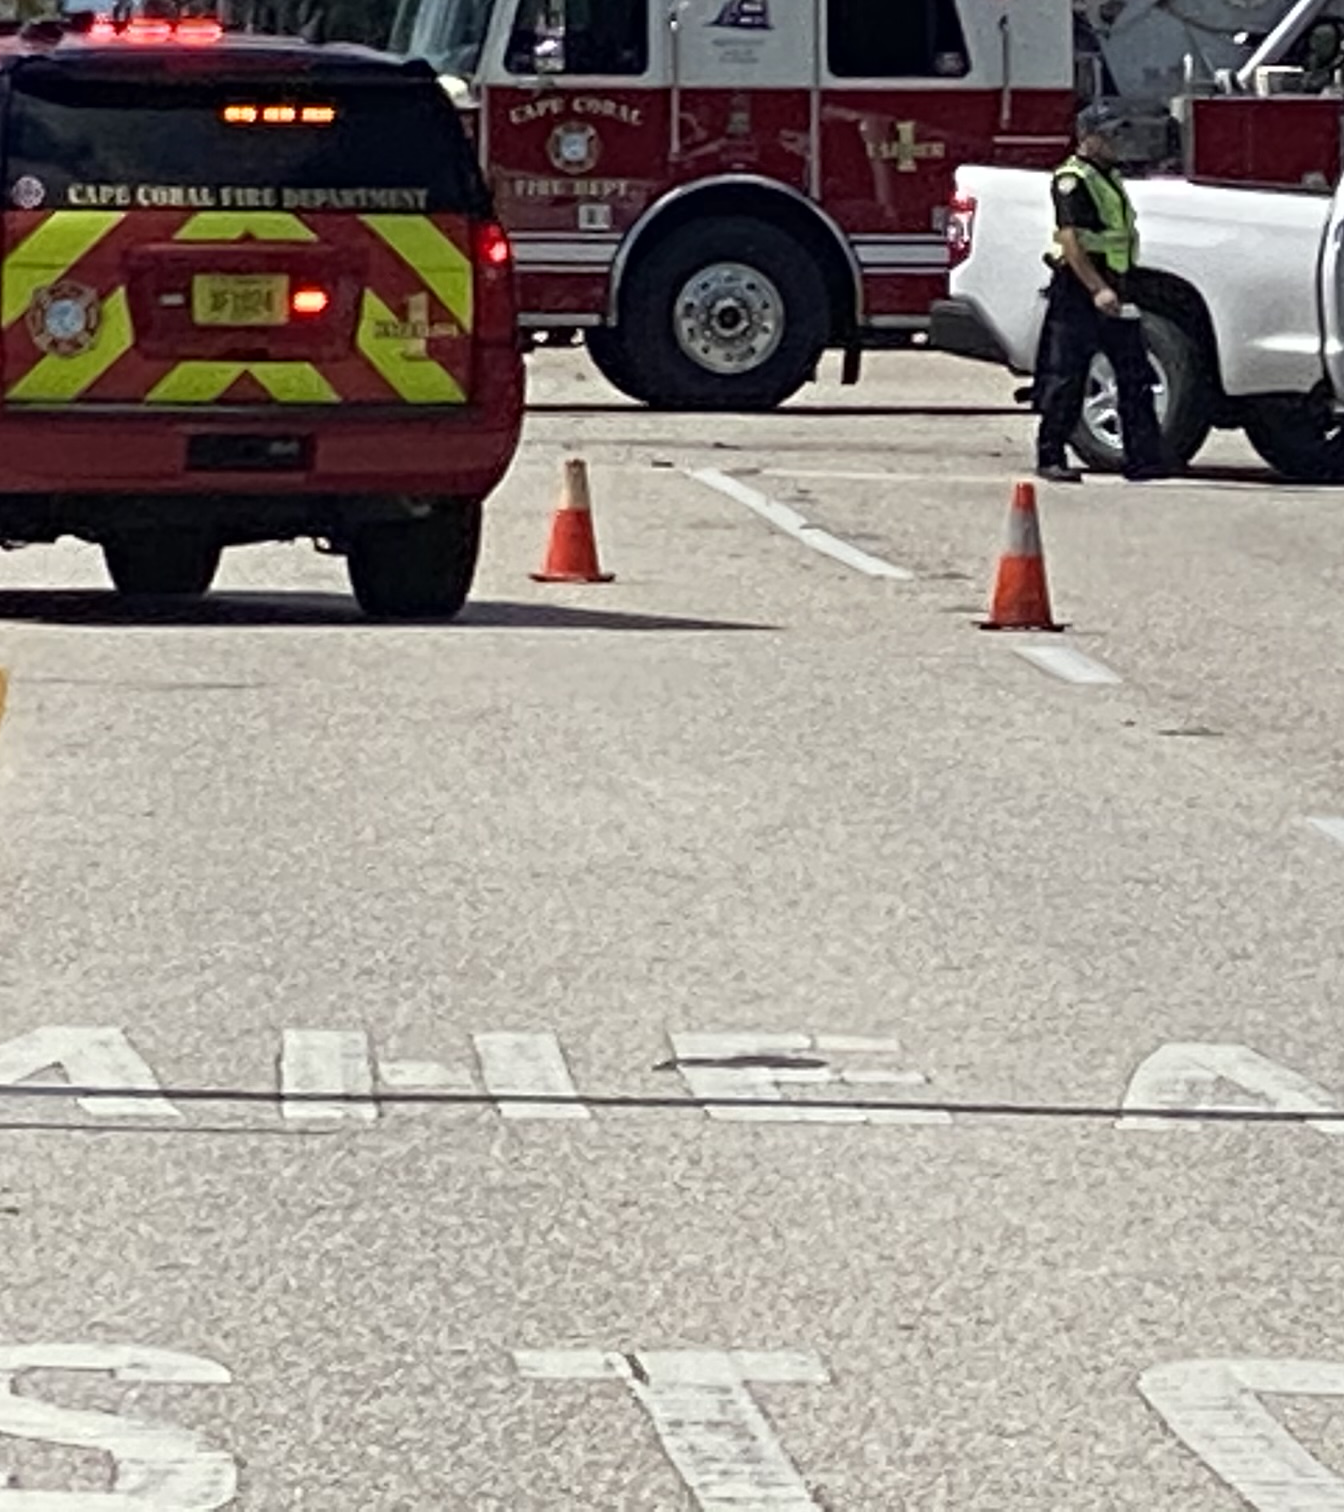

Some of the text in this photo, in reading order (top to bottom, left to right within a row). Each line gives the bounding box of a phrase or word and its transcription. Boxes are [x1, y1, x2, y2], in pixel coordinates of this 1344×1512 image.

[509, 96, 644, 127] CAPE CORAL
[67, 183, 429, 210] CAPE CORAL FIRE DEPARTMENT
[514, 179, 563, 196] FIRE
